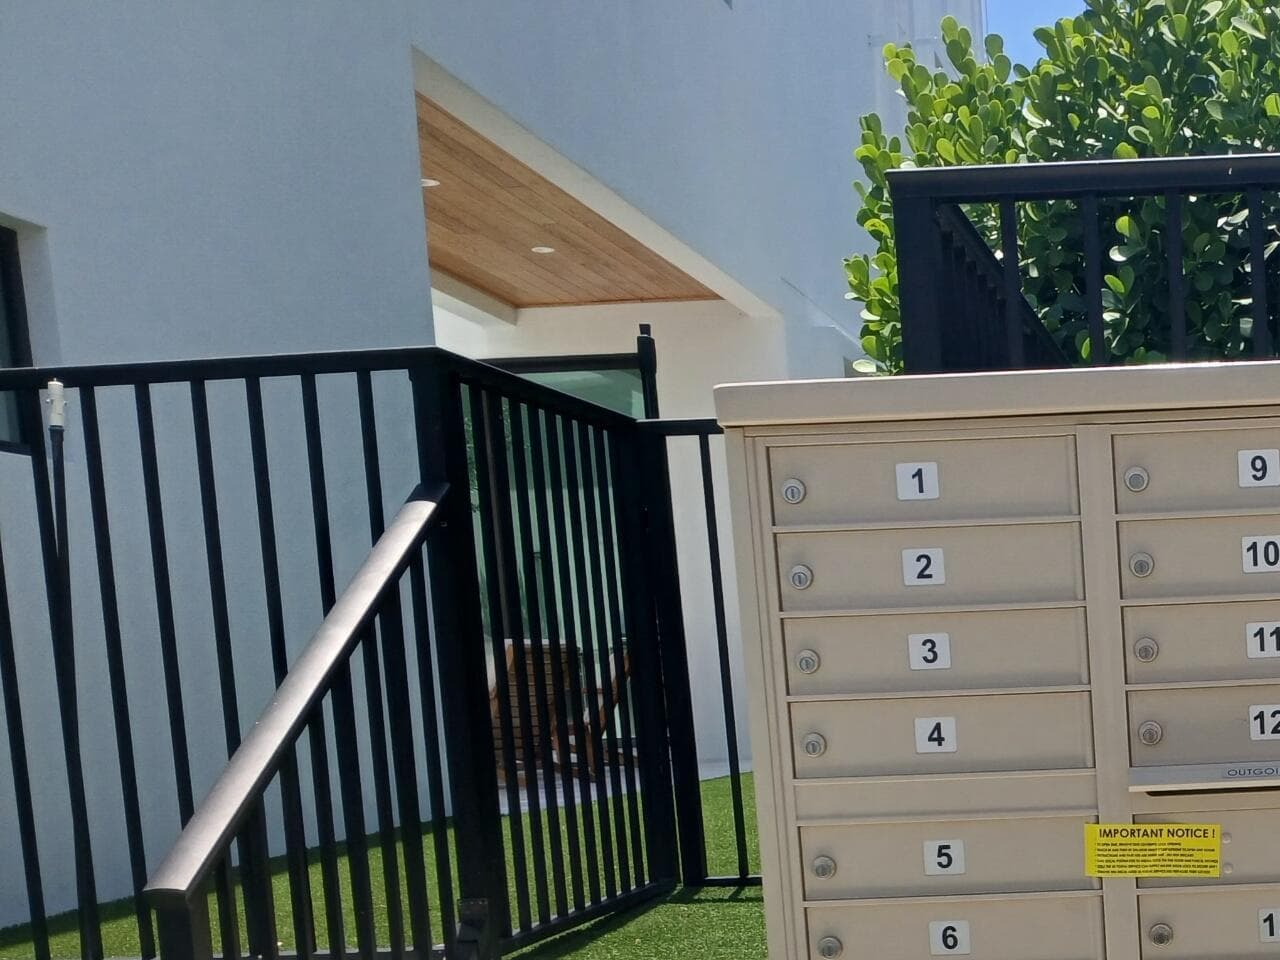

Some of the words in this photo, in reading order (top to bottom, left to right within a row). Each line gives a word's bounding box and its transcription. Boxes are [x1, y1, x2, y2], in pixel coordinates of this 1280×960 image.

[911, 467, 924, 494] 1
[1250, 455, 1268, 482] 9
[915, 553, 933, 580] 2
[1246, 540, 1280, 567] 10
[921, 638, 938, 664] 3
[927, 721, 946, 747] 4
[1099, 828, 1163, 839] IMPORTANT
[1167, 828, 1209, 839] NOTICE
[936, 844, 953, 869] 5
[941, 925, 959, 950] 6
